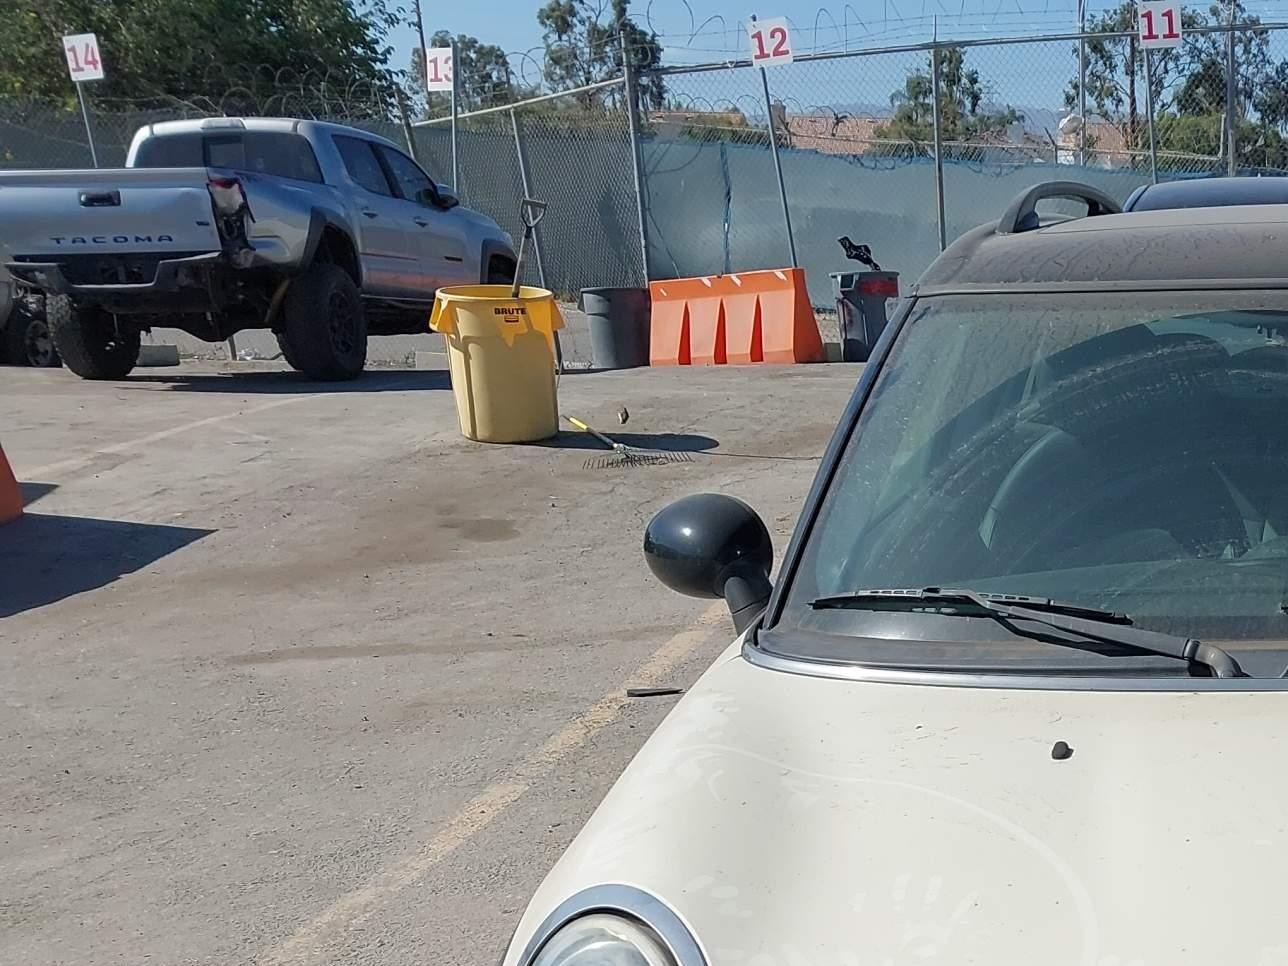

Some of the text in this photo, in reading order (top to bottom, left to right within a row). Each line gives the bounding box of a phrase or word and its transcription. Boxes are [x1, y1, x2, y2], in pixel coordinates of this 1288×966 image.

[1141, 9, 1179, 40] 11
[67, 43, 98, 72] 14
[751, 27, 789, 59] 12
[51, 235, 174, 244] TACOMA
[494, 307, 527, 315] BRUTE
